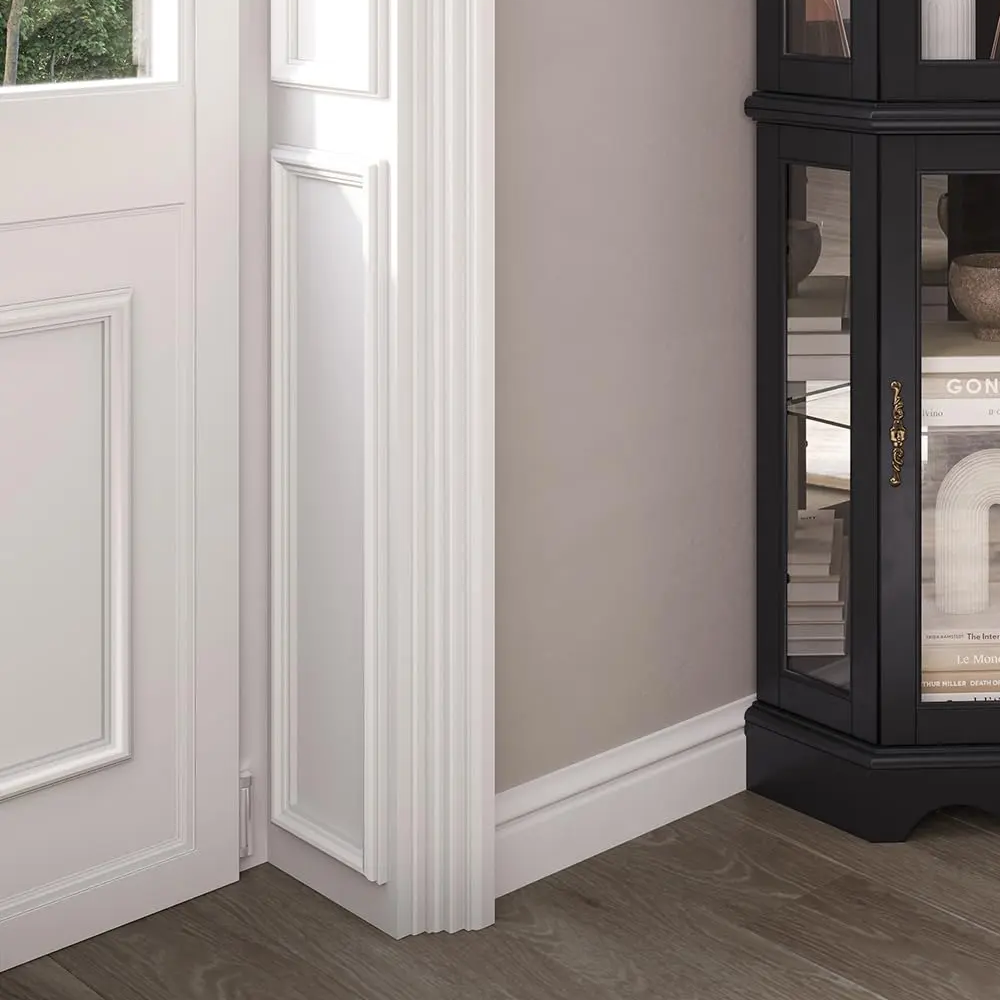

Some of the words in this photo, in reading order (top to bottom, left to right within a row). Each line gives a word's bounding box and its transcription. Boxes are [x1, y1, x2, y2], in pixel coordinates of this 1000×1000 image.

[967, 632, 981, 640] The
[957, 654, 970, 665] Le
[970, 679, 992, 687] DEATH
[992, 679, 1000, 687] OF
